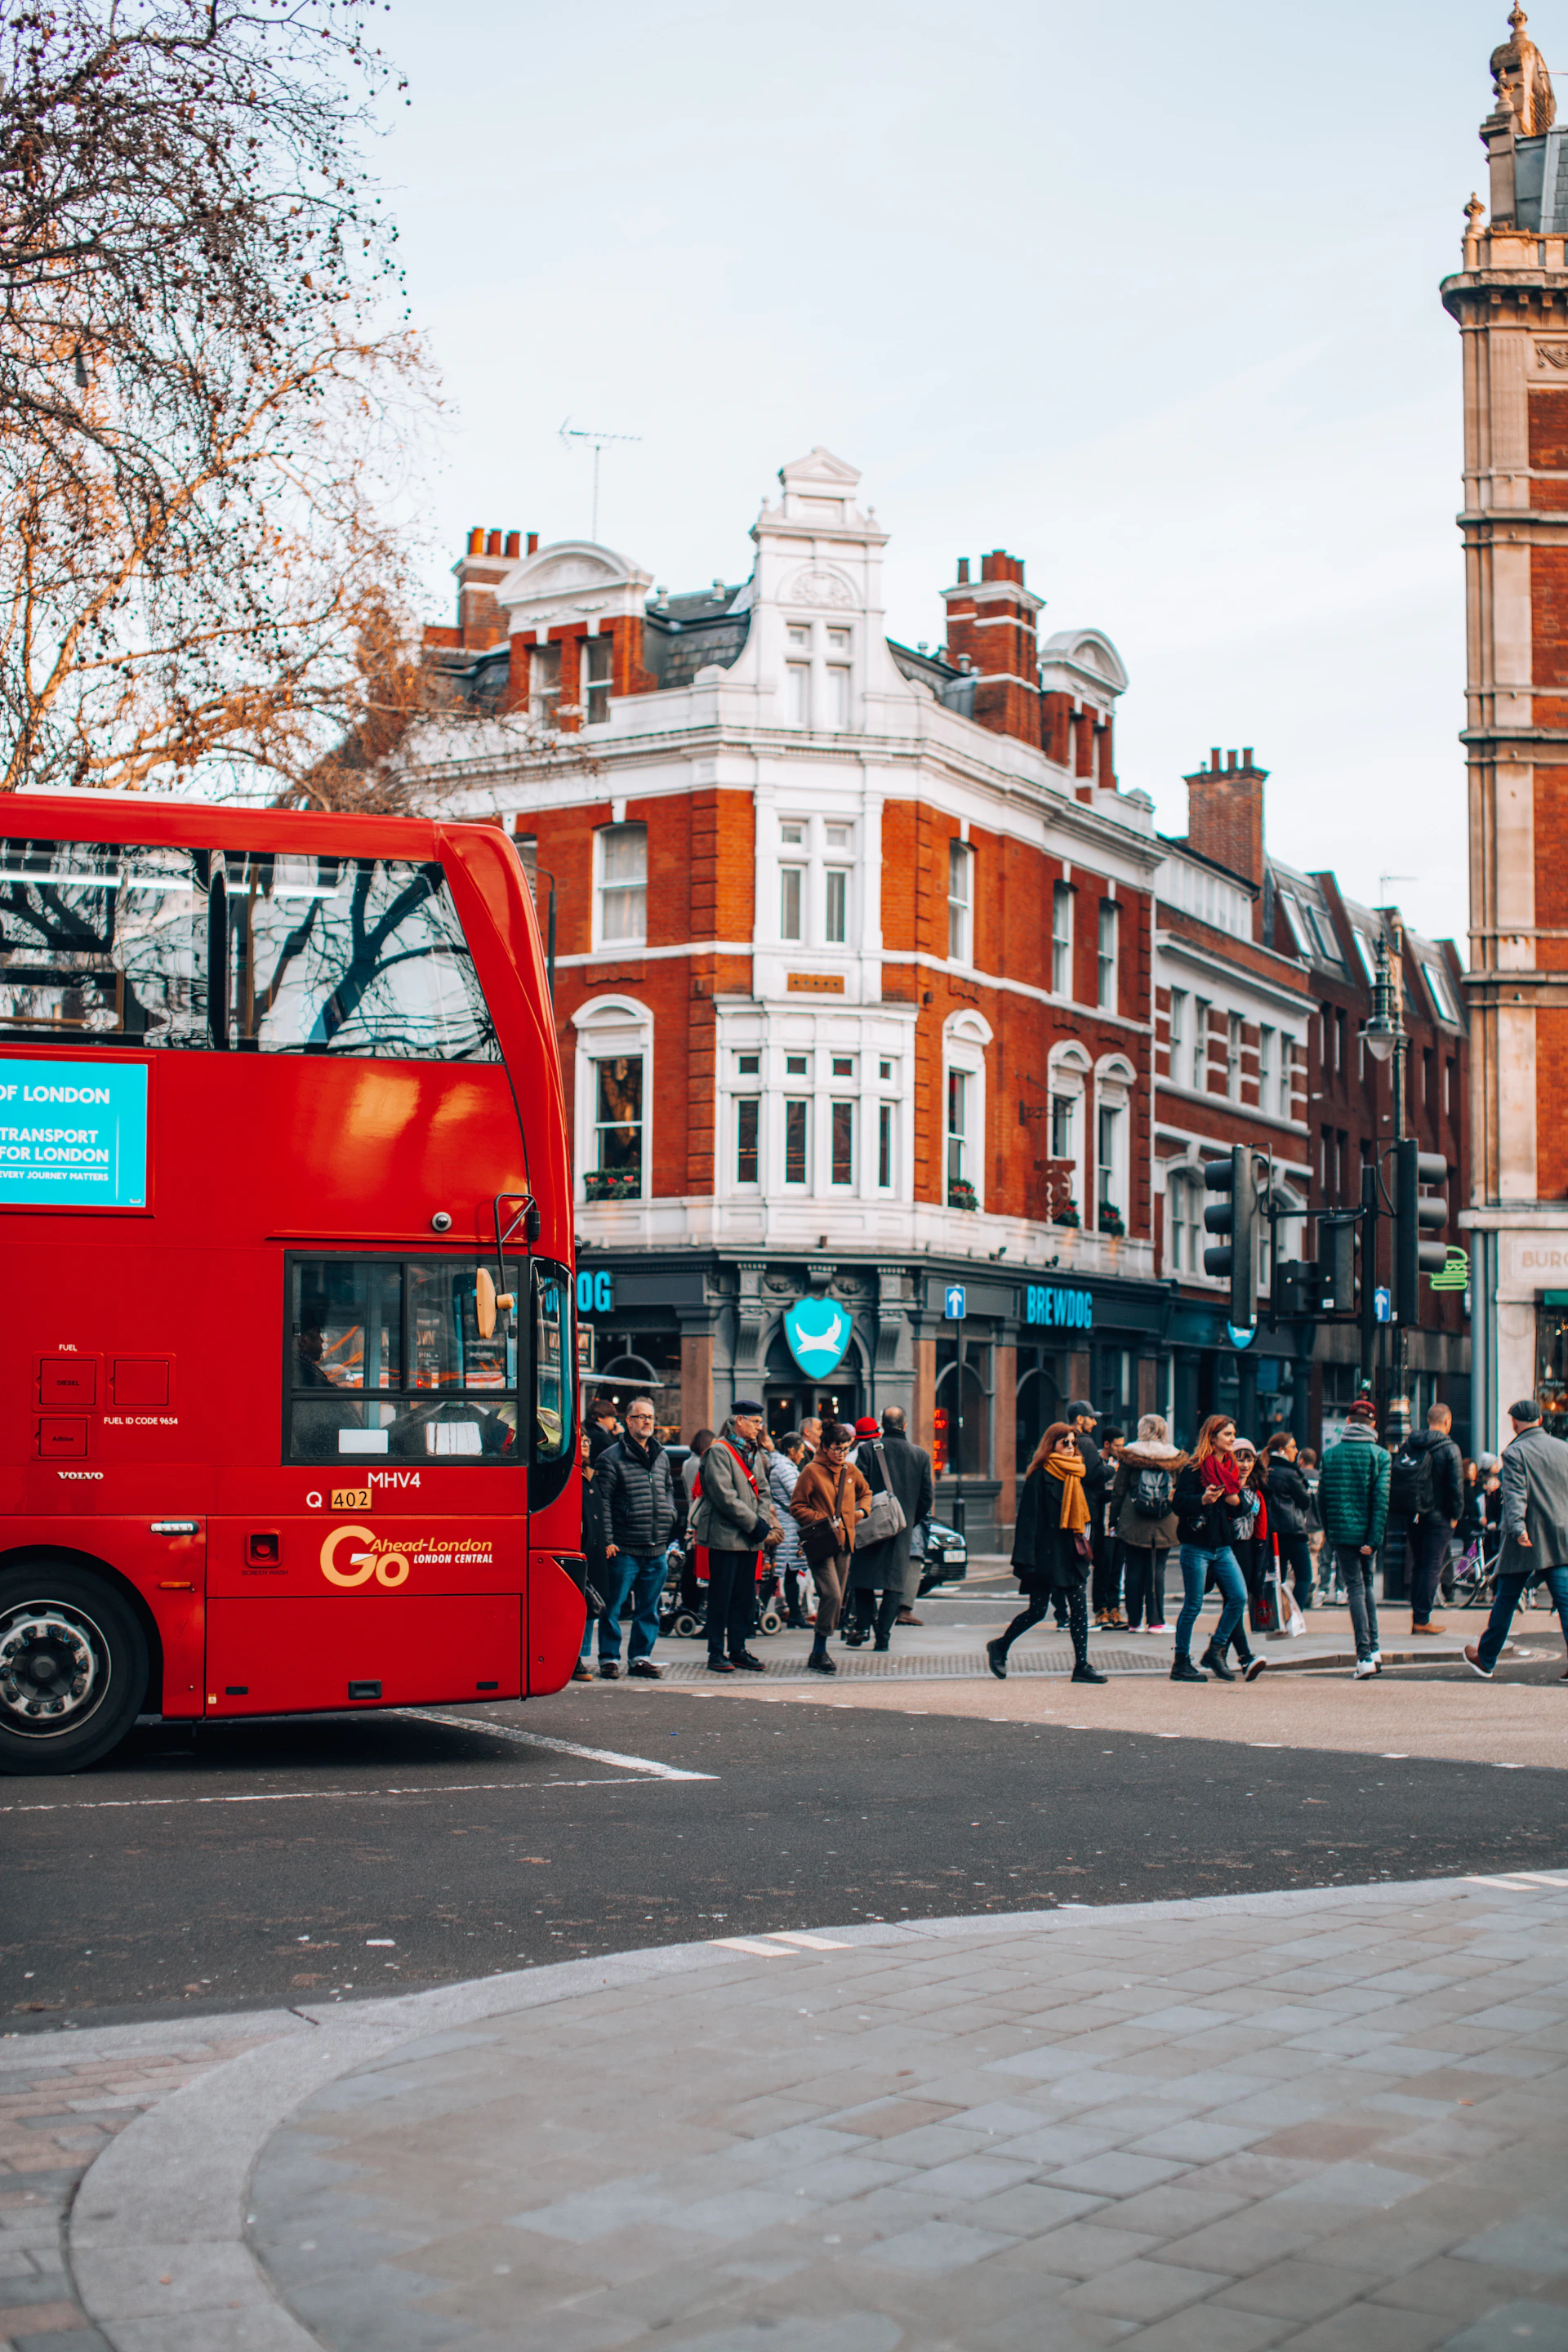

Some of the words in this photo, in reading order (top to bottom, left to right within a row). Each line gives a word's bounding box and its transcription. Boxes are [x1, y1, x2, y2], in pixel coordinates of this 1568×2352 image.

[24, 1085, 110, 1104] LONDON
[0, 1127, 99, 1143] TRANSPORT
[0, 1146, 31, 1160] FOR
[34, 1147, 109, 1163] LONDON
[27, 1171, 68, 1180] JOURNEY
[69, 1173, 109, 1181] MATTERS
[1027, 1285, 1093, 1330] BREWDOG
[59, 1343, 78, 1352] FUEL
[104, 1417, 123, 1425] FUEL
[125, 1417, 134, 1425] ID
[135, 1417, 158, 1425] CODE
[159, 1417, 178, 1425] 9654
[57, 1472, 104, 1480] VOLVO
[368, 1472, 421, 1488] MHV4
[305, 1491, 323, 1508] Q
[333, 1490, 368, 1508] 402
[320, 1525, 409, 1588] Go
[413, 1554, 452, 1564] LONDON
[454, 1553, 493, 1564] CENTRAL
